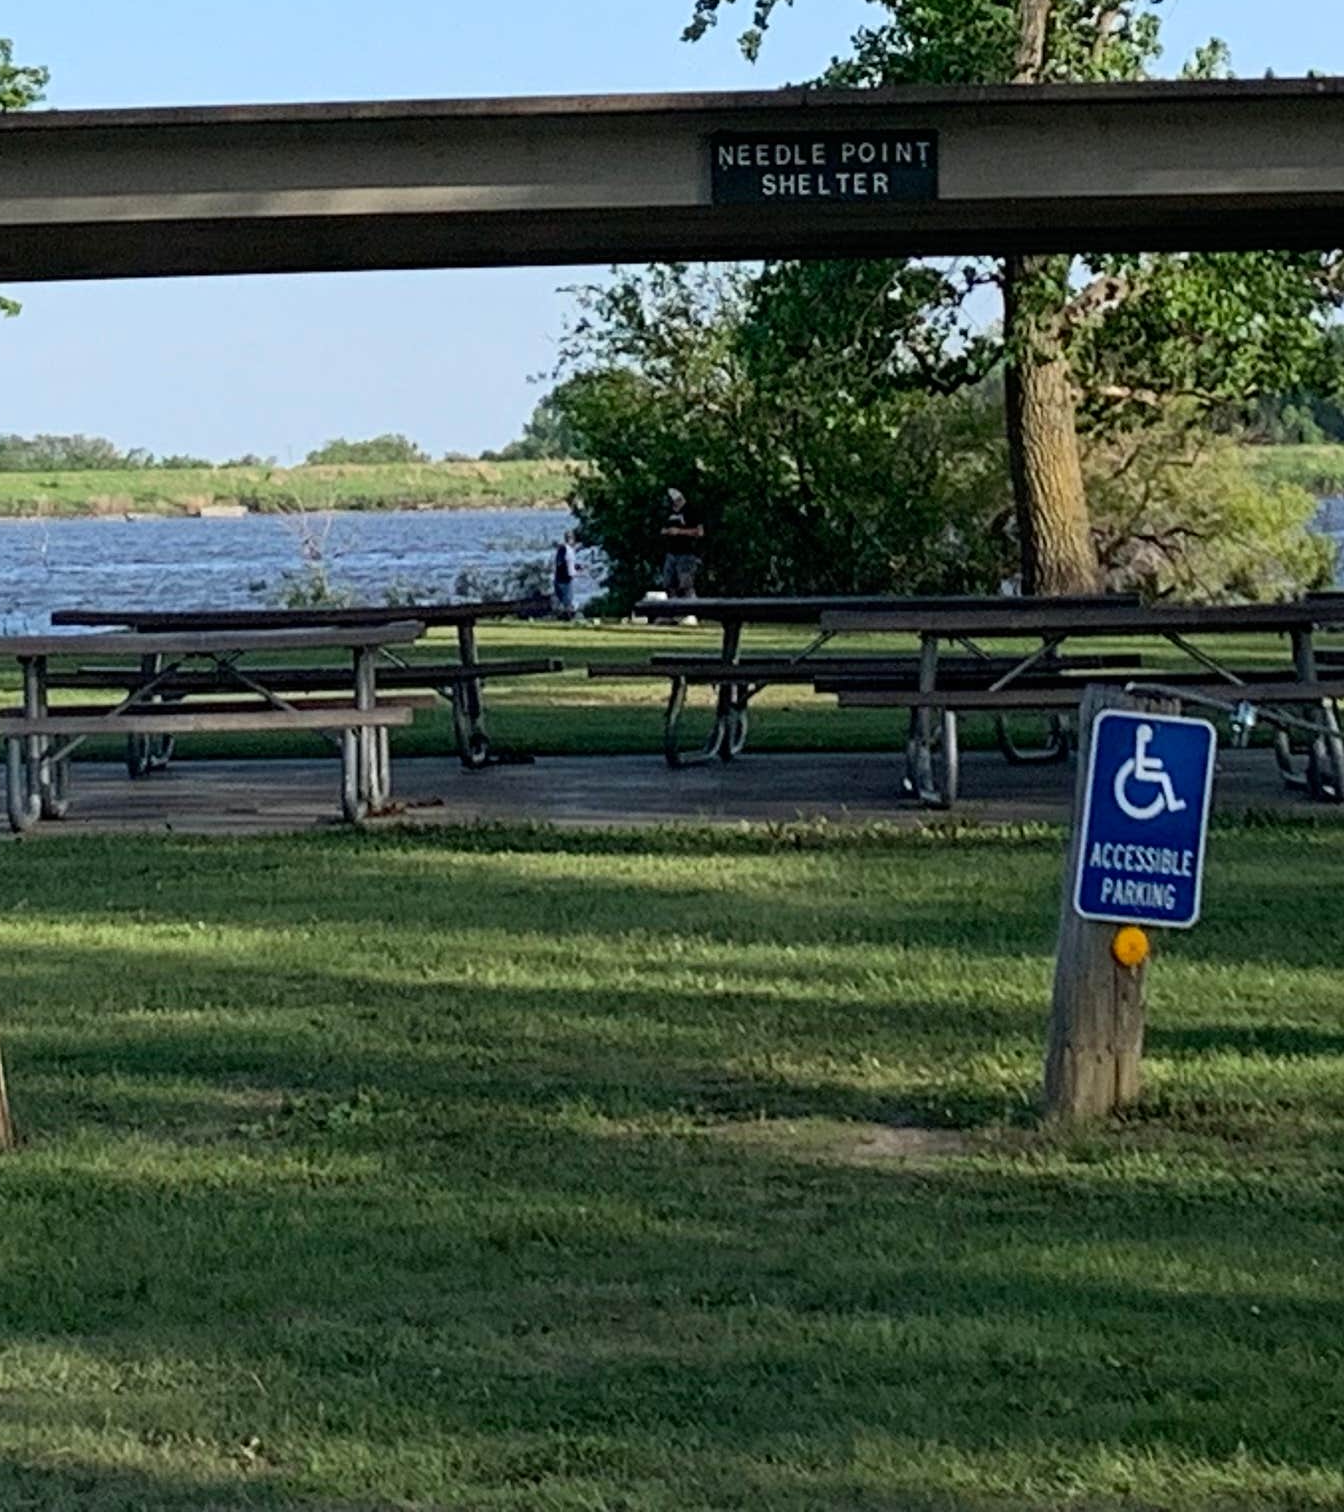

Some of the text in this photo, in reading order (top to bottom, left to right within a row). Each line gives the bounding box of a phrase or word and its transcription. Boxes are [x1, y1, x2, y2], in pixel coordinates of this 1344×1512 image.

[718, 142, 930, 167] NEEDLE POINT
[761, 172, 889, 196] SHELTER
[1090, 842, 1194, 877] ACCESSIBLE
[1100, 877, 1177, 910] PARKING
